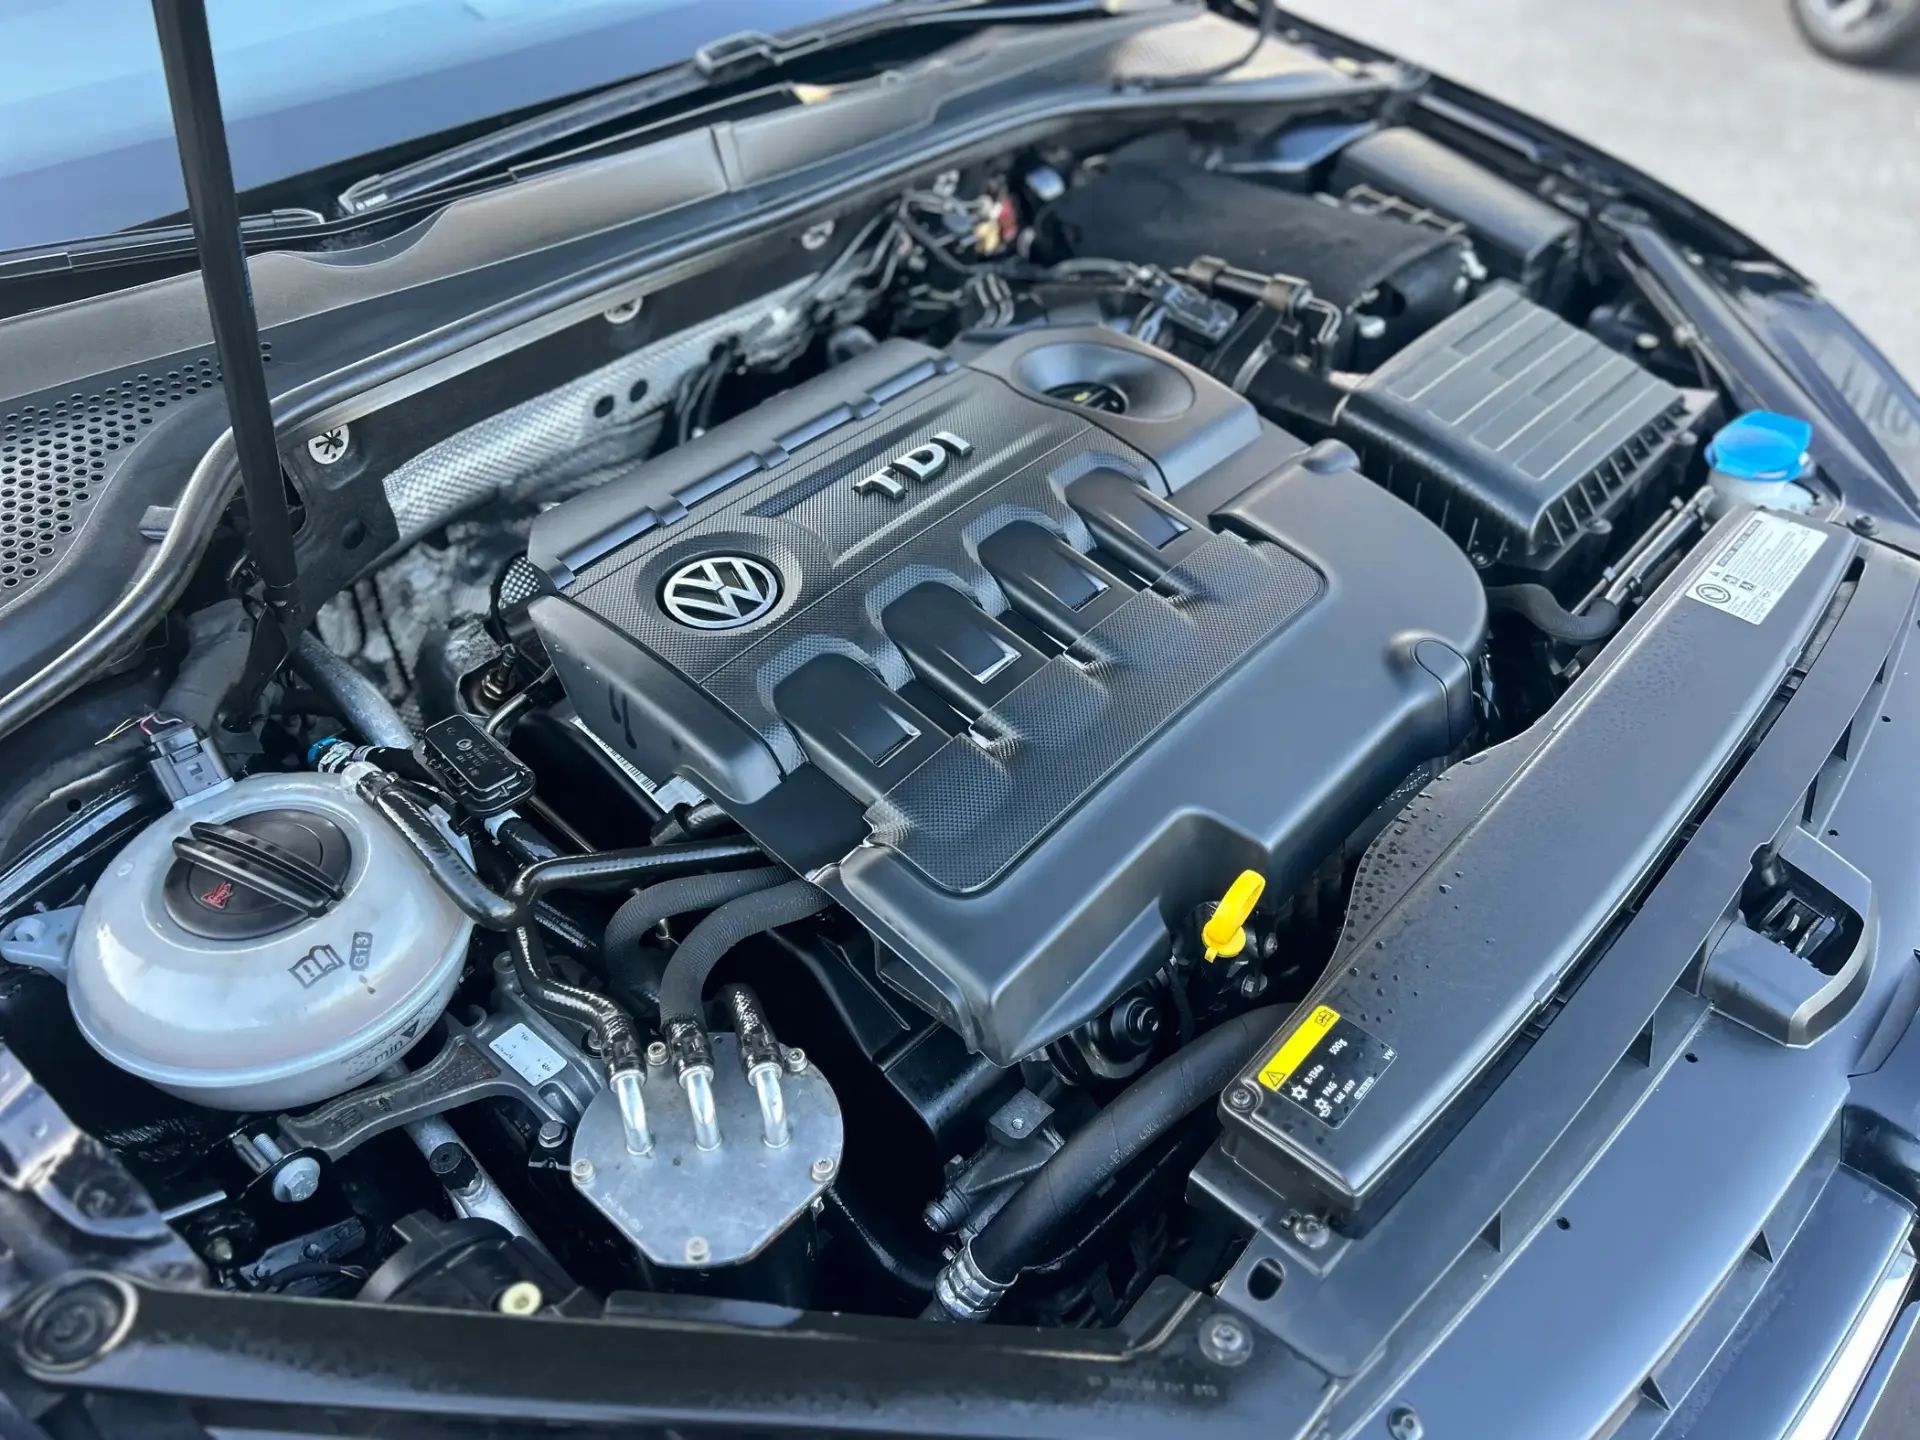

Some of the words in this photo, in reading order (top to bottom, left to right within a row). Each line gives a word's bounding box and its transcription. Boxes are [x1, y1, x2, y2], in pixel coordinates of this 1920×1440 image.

[853, 430, 974, 501] TDI
[663, 555, 779, 630] VW
[353, 936, 369, 967] G13
[374, 1040, 404, 1065] min
[1304, 1064, 1324, 1085] R-134a
[1328, 1038, 1348, 1055] 500g
[1382, 1049, 1395, 1061] VW
[1322, 1081, 1338, 1097] PAG
[1334, 1091, 1346, 1104] SAE
